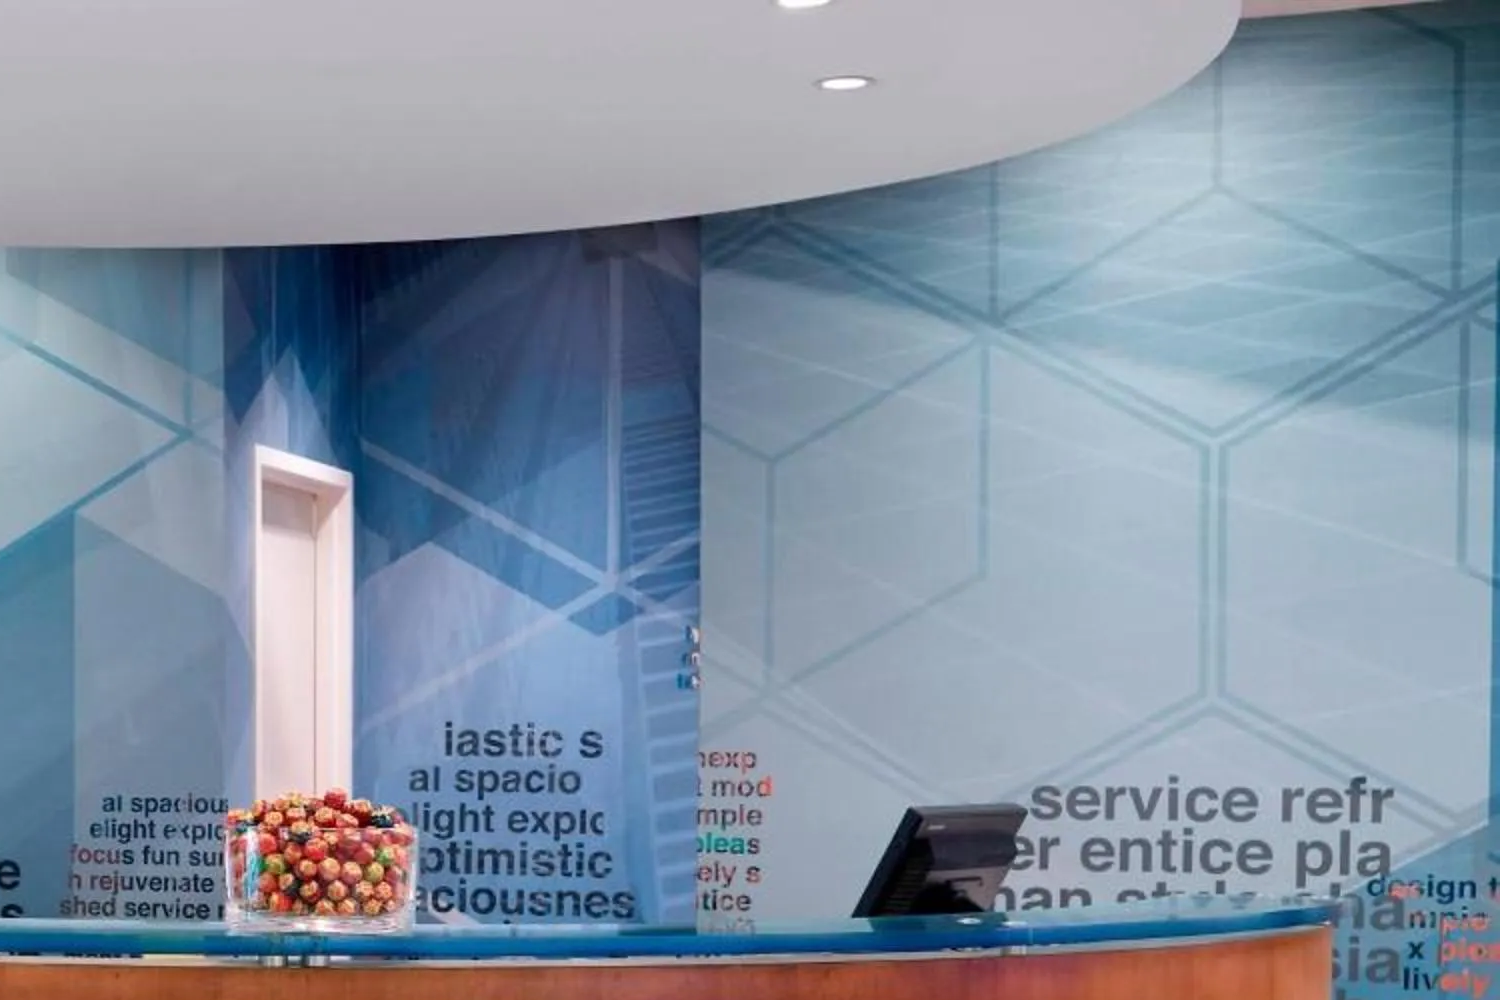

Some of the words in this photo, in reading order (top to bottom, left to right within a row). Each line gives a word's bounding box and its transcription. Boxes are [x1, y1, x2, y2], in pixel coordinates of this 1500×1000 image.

[445, 722, 563, 758] iastic
[579, 731, 604, 759] s
[409, 766, 441, 793] al
[455, 764, 582, 800] spacio
[102, 795, 123, 813] al
[1030, 776, 1258, 824] service
[1281, 777, 1394, 824] refr
[90, 818, 156, 845] elight
[70, 843, 135, 866] focus
[142, 845, 180, 867] fun
[1079, 828, 1274, 876] entice
[1295, 829, 1392, 889] pla
[89, 870, 215, 896] rejuvenate
[1367, 873, 1477, 905] design
[59, 896, 117, 917] shed
[124, 900, 212, 920] service
